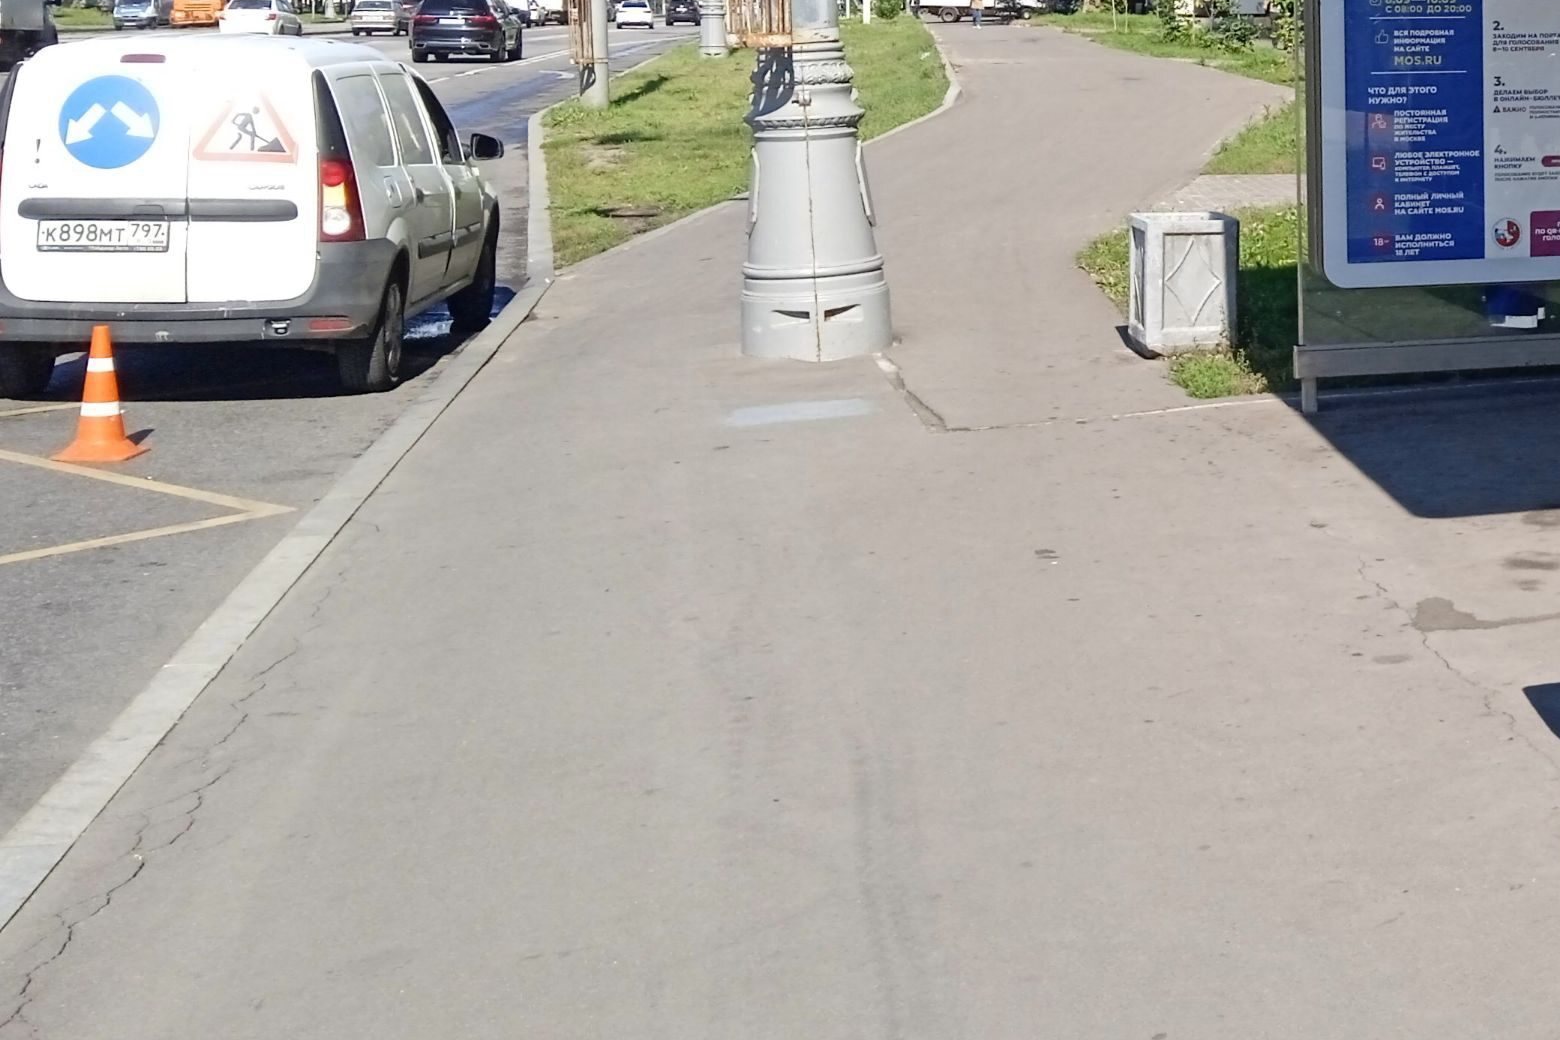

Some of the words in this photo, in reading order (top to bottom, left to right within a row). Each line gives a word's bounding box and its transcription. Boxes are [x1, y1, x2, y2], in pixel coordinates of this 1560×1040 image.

[1427, 5, 1441, 13] ДО
[1444, 5, 1472, 13] 20:00
[1493, 21, 1504, 30] 2.
[1394, 56, 1442, 65] MOS.RU
[1493, 76, 1505, 86] 3.
[1494, 144, 1507, 154] 4.
[1424, 150, 1480, 158] ЭЛЕКТРОННОЕ
[1395, 192, 1429, 200] ПОЛНЫЙ
[1431, 191, 1464, 199] ЛИЧНЫЙ
[46, 223, 125, 242] К898МТ
[131, 223, 163, 238] 797
[1415, 233, 1451, 241] ДОЛЖНО
